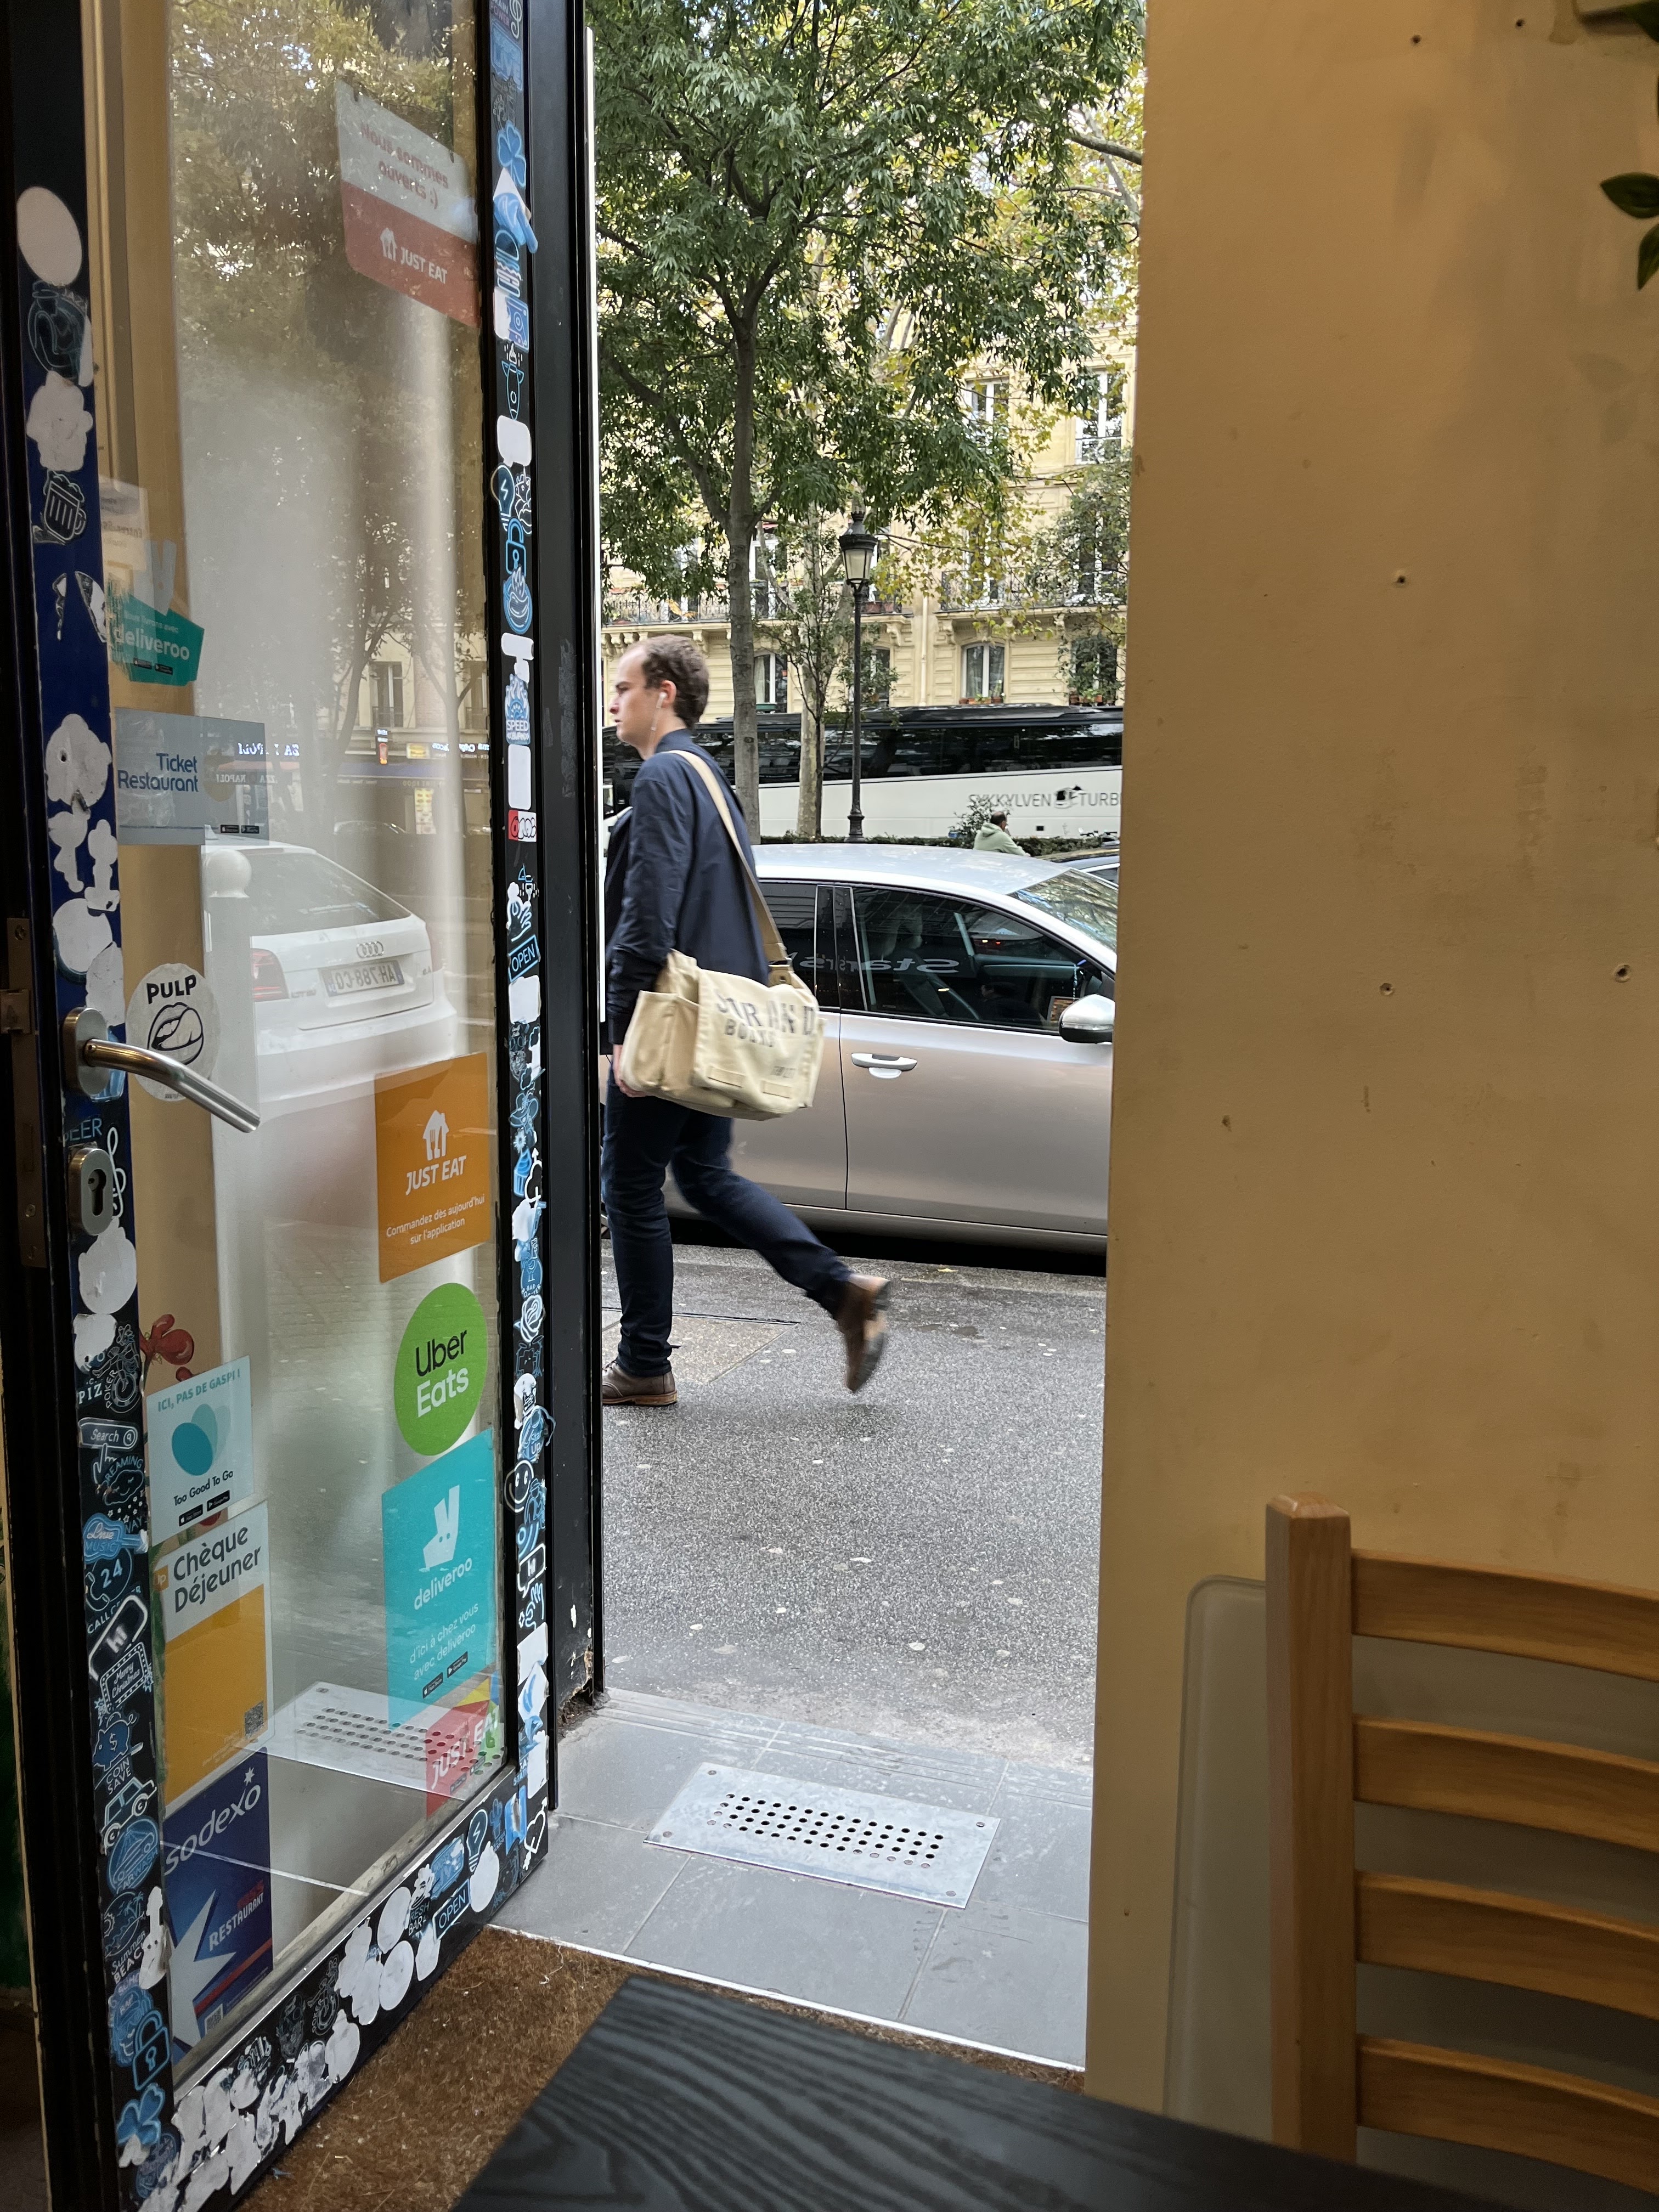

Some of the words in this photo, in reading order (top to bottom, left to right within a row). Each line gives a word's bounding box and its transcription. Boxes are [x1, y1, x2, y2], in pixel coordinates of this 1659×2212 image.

[362, 122, 393, 154] Nous
[396, 146, 448, 189] sommes
[379, 160, 426, 200] ouverts
[400, 247, 426, 273] JUST
[428, 261, 447, 284] EAT
[113, 623, 190, 661] deliveroo
[506, 719, 529, 732] SPEED
[117, 770, 199, 792] Restaurant
[156, 752, 198, 774] Ticket
[1078, 792, 1122, 806] TURB
[511, 943, 535, 972] OPEN
[146, 974, 197, 1005] PULP
[405, 1163, 439, 1196] JUST
[442, 1155, 467, 1181] EAT
[386, 1214, 433, 1237] Commandez
[434, 1208, 447, 1221] dès
[448, 1193, 485, 1216] aujourd'hui
[410, 1233, 422, 1245] sur
[424, 1217, 466, 1241] l'application
[415, 1329, 467, 1377] Uber
[104, 1369, 118, 1409] POKER
[157, 1397, 175, 1413] ICI,
[176, 1388, 194, 1404] PAS
[195, 1382, 207, 1396] DE
[210, 1370, 235, 1390] GASPI
[417, 1368, 469, 1418] Eats
[91, 1429, 120, 1443] Search
[173, 1494, 187, 1506] Too
[189, 1478, 211, 1498] Good
[212, 1476, 221, 1486] To
[222, 1470, 234, 1481] Go
[86, 1540, 116, 1553] MUSIC
[174, 1527, 249, 1581] Chèque
[100, 1558, 123, 1589] 24
[175, 1545, 262, 1613] Déjeuner
[414, 1557, 473, 1611] deliveroo
[87, 1611, 110, 1634] CALL
[410, 1639, 428, 1664] d'ici
[430, 1634, 436, 1649] à
[437, 1618, 459, 1642] chez
[459, 1603, 479, 1624] vous
[414, 1656, 436, 1681] avec
[437, 1623, 476, 1662] deliveroo
[112, 1669, 141, 1699] Christmas
[114, 1662, 134, 1685] Merry
[106, 1757, 131, 1784] COIN
[431, 1731, 471, 1791] JUST
[108, 1766, 132, 1796] SAVE
[164, 1784, 261, 1876] sodexo
[134, 1848, 159, 1878] WASH
[209, 1892, 264, 1952] RESTAURANT
[438, 1889, 466, 1929] OPEN
[114, 1943, 144, 1985] BEAC
